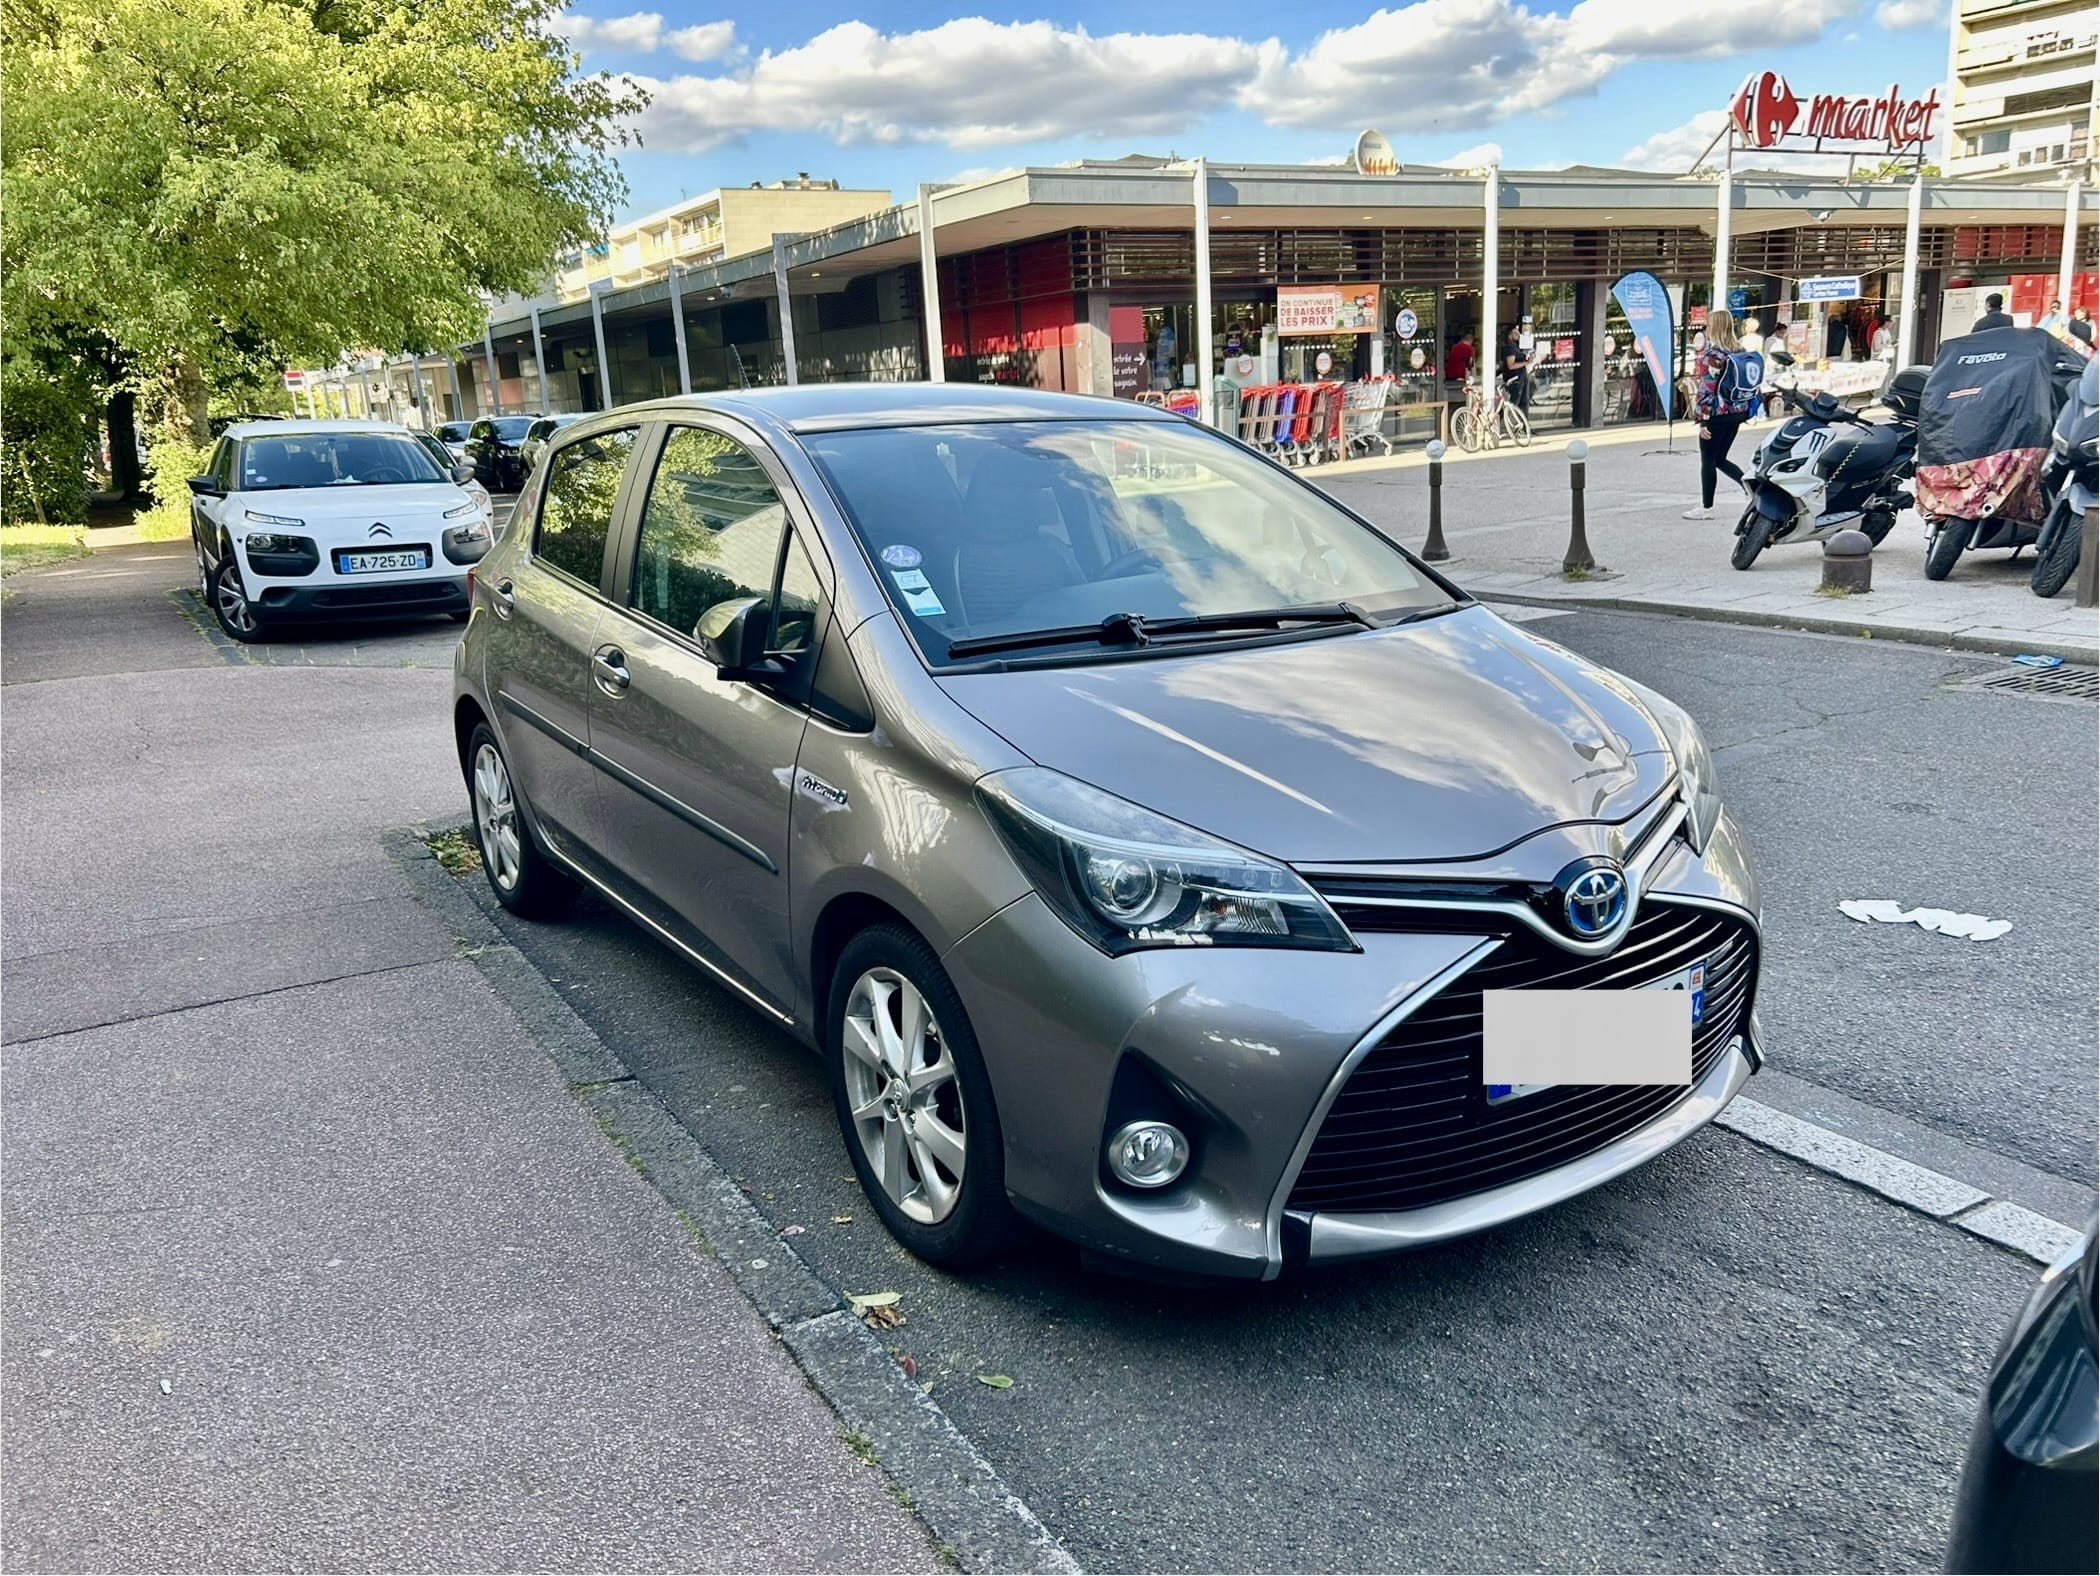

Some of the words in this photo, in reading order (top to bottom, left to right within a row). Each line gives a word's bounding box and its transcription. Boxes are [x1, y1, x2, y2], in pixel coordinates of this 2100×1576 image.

[1806, 84, 1940, 148] market
[1293, 298, 1333, 307] CONTINUE
[1281, 308, 1291, 316] DE
[1294, 306, 1333, 316] BAISSER
[1281, 317, 1298, 327] LES
[1301, 316, 1327, 326] PRIX
[351, 554, 416, 570] EA-725-ZD
